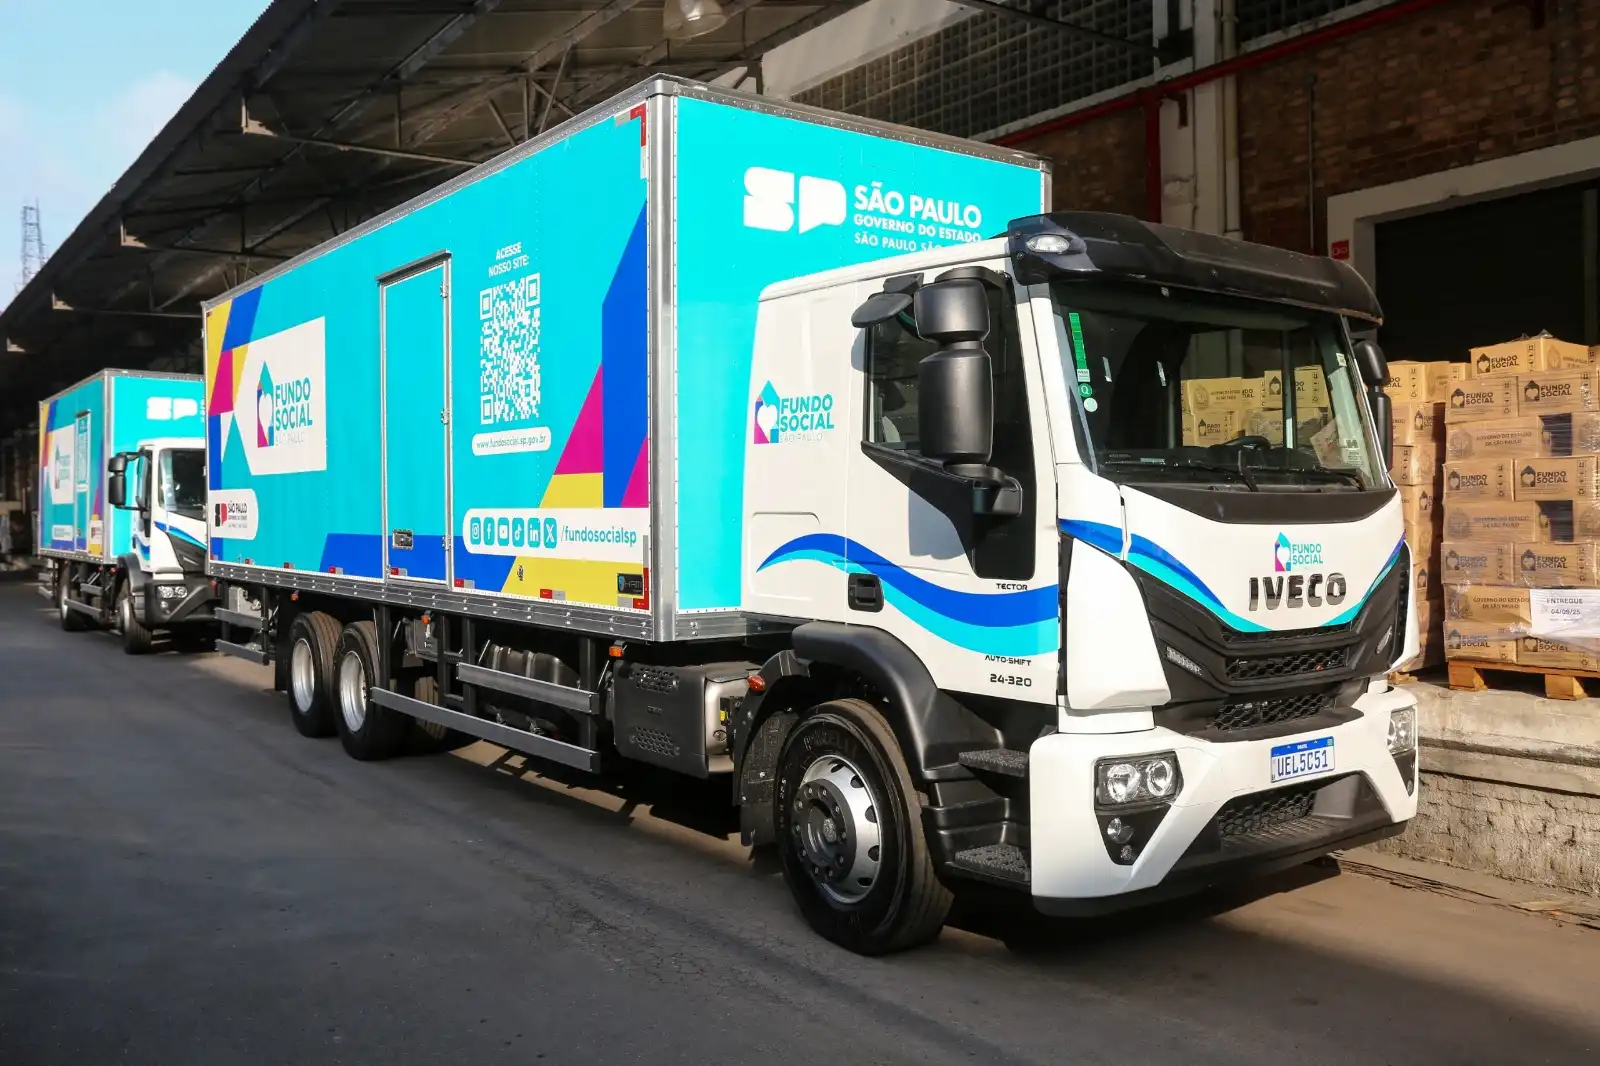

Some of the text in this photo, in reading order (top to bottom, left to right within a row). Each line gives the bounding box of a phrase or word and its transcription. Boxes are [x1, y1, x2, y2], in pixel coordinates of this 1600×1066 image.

[854, 181, 982, 228] SÃO PAULO
[853, 213, 981, 243] GOVERNO DO ESTADO
[496, 241, 522, 260] ACESSE
[854, 230, 878, 246] SÃO
[882, 236, 917, 252] PAULO
[488, 259, 512, 278] NOSSO
[1491, 354, 1518, 364] FUNDO
[1491, 361, 1520, 369] SOCIAL
[275, 377, 311, 407] FUNDO
[1465, 391, 1494, 399] FUNDO
[1540, 383, 1571, 391] FUNDO
[1540, 390, 1572, 398] SOCIAL
[780, 393, 833, 415] FUNDO
[275, 402, 313, 431] SOCIAL
[780, 412, 835, 432] SOCIAL
[476, 432, 546, 449] www.fundosocial.sp.gov.br
[560, 525, 637, 547] /fundosocialsp
[1292, 543, 1322, 554] FUNDO
[1292, 553, 1324, 565] SOCIAL
[996, 583, 1028, 591] TECTOR
[1249, 572, 1347, 612] IVECO
[990, 673, 1032, 687] 24-320
[1277, 749, 1328, 777] UEL5C51
